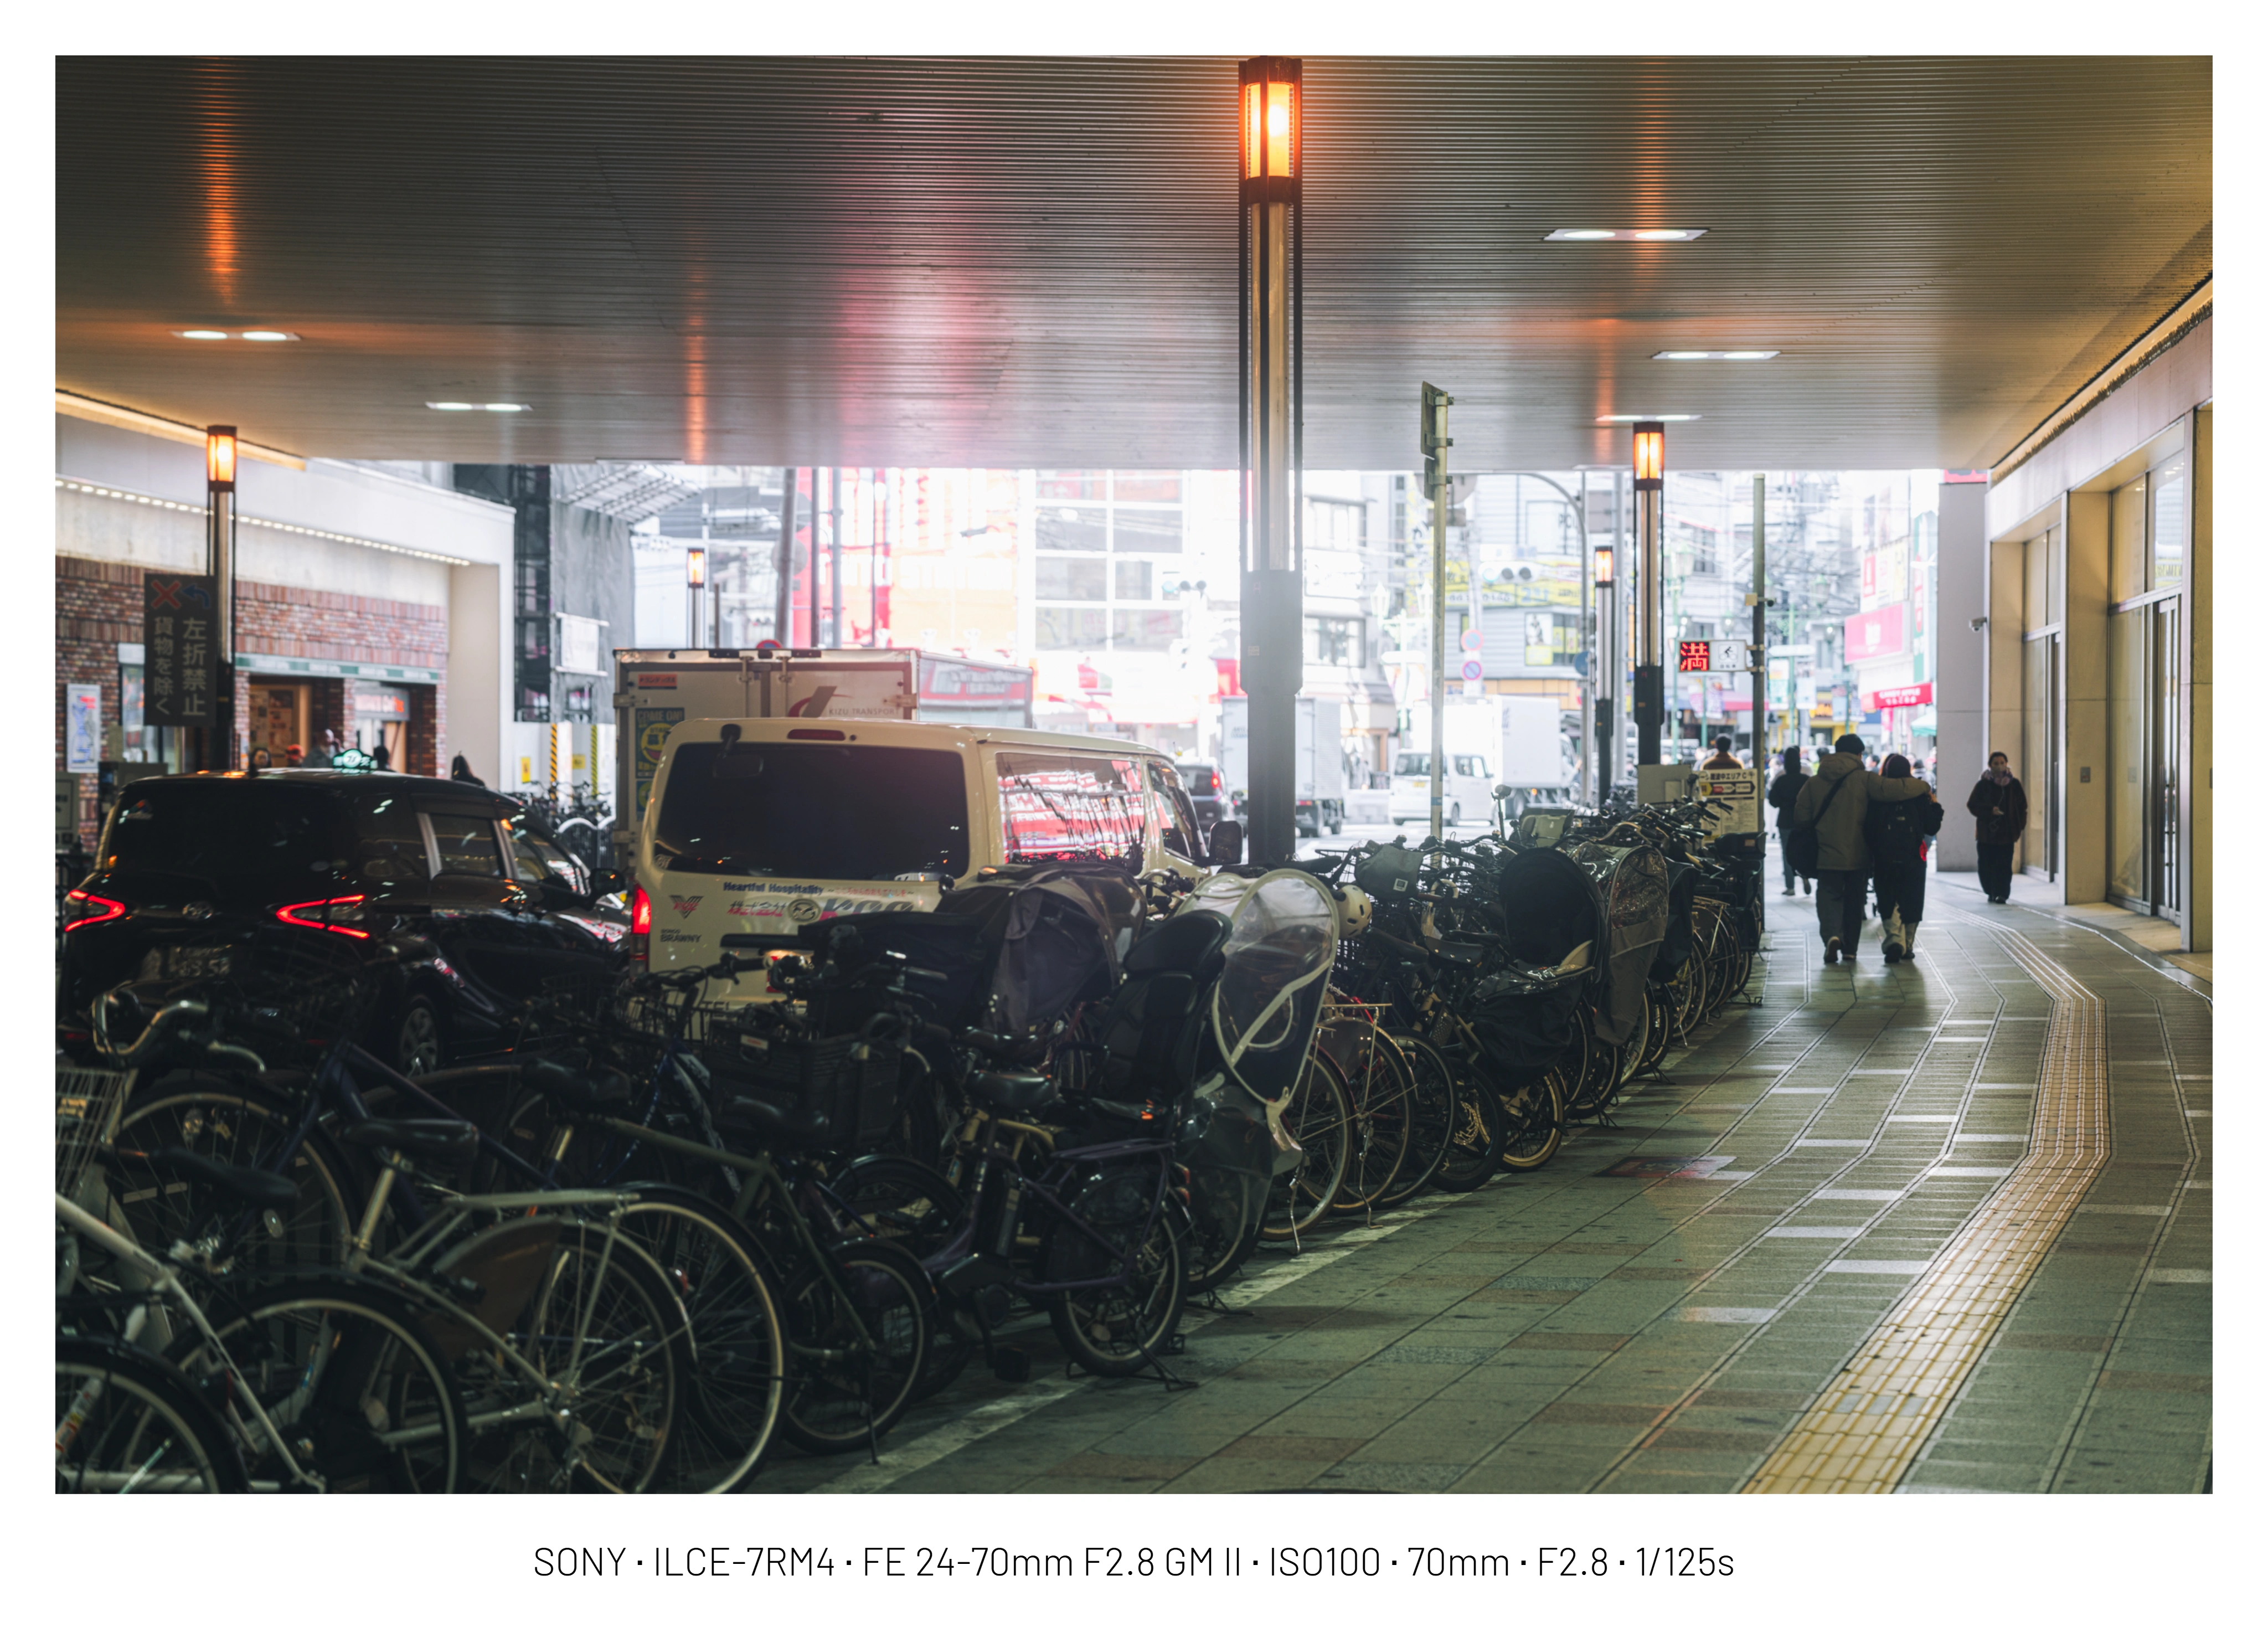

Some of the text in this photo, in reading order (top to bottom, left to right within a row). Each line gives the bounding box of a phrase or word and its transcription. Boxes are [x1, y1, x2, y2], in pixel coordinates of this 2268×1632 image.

[153, 616, 174, 715] 貨物を除く
[182, 617, 207, 717] 左折禁止
[1680, 642, 1709, 671] 満
[637, 710, 664, 721] COME
[723, 882, 824, 895] Heartful Hospitality
[660, 934, 703, 943] BRAWNY
